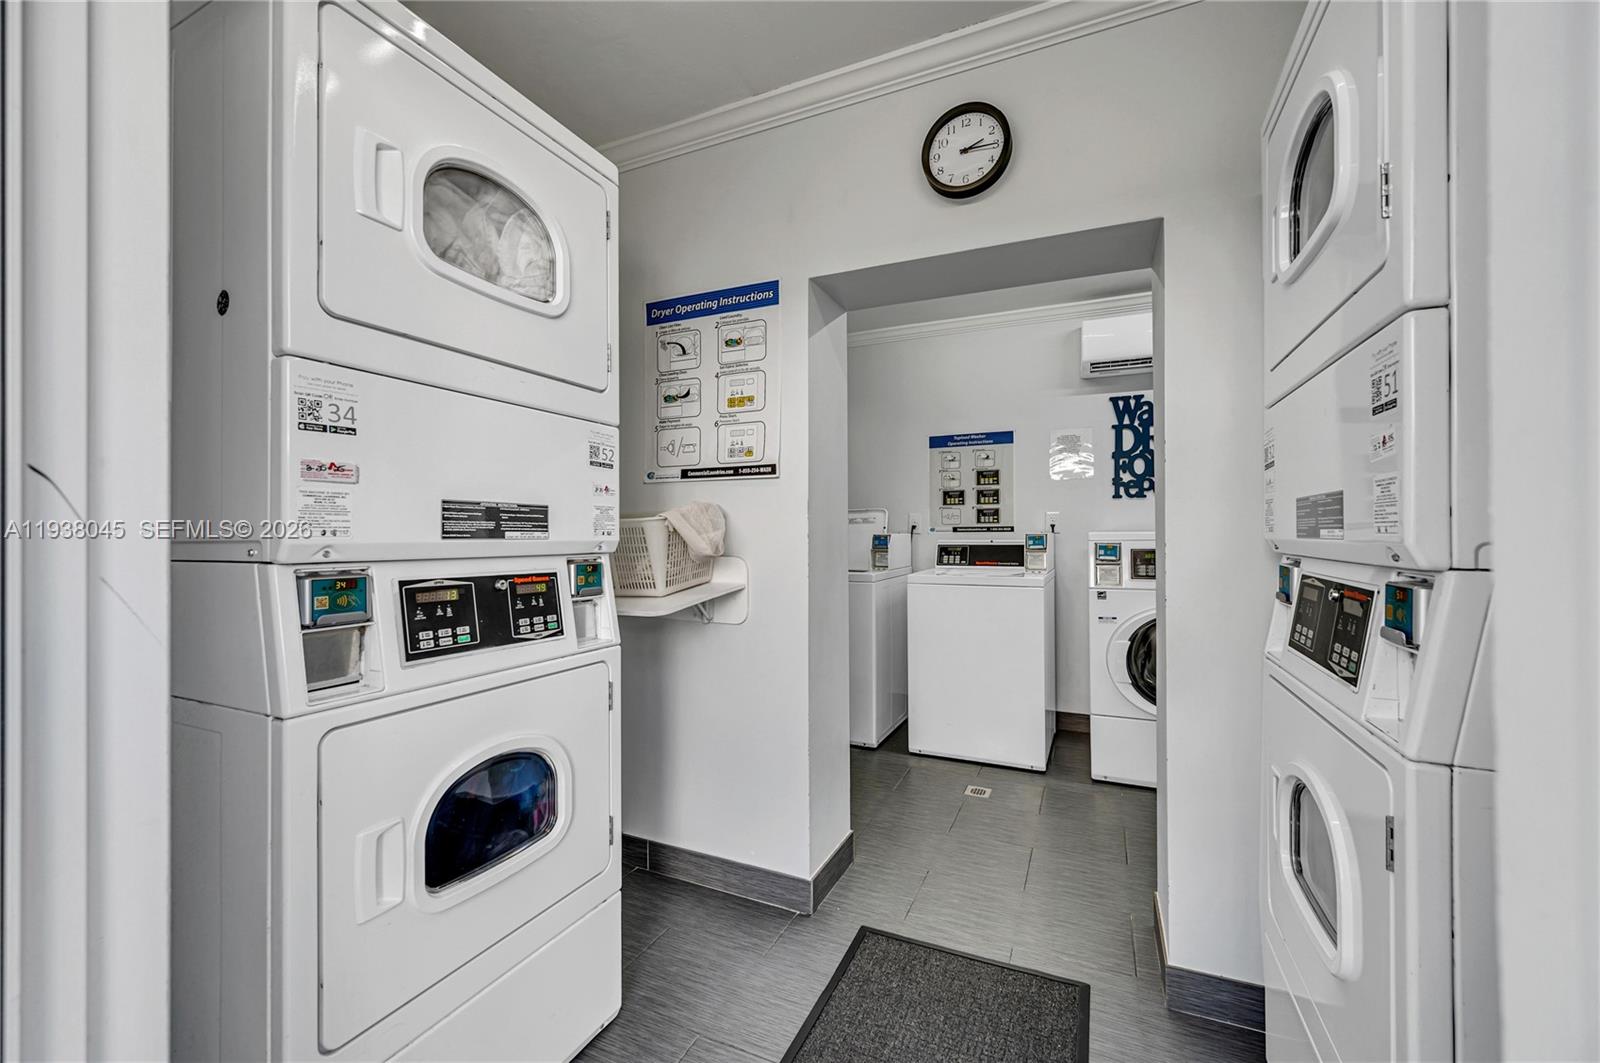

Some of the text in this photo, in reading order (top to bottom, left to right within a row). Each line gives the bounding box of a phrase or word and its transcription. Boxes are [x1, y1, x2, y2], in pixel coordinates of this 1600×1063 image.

[961, 118, 971, 128] 12
[979, 118, 983, 127] 1
[947, 125, 956, 135] 11
[988, 125, 995, 135] 2
[938, 138, 948, 149] 10
[933, 153, 940, 163] 9
[988, 155, 995, 163] 4
[937, 167, 944, 176] 8
[977, 167, 984, 177] 5
[948, 173, 955, 183] 7
[962, 174, 969, 184] 6
[651, 290, 774, 319] Dryer Operating Instructions
[714, 321, 720, 330] 2
[1384, 370, 1399, 399] 51
[328, 403, 357, 425] 34
[654, 425, 659, 433] 5
[714, 420, 719, 428] 6
[602, 447, 615, 462] 52
[335, 581, 346, 590] 34
